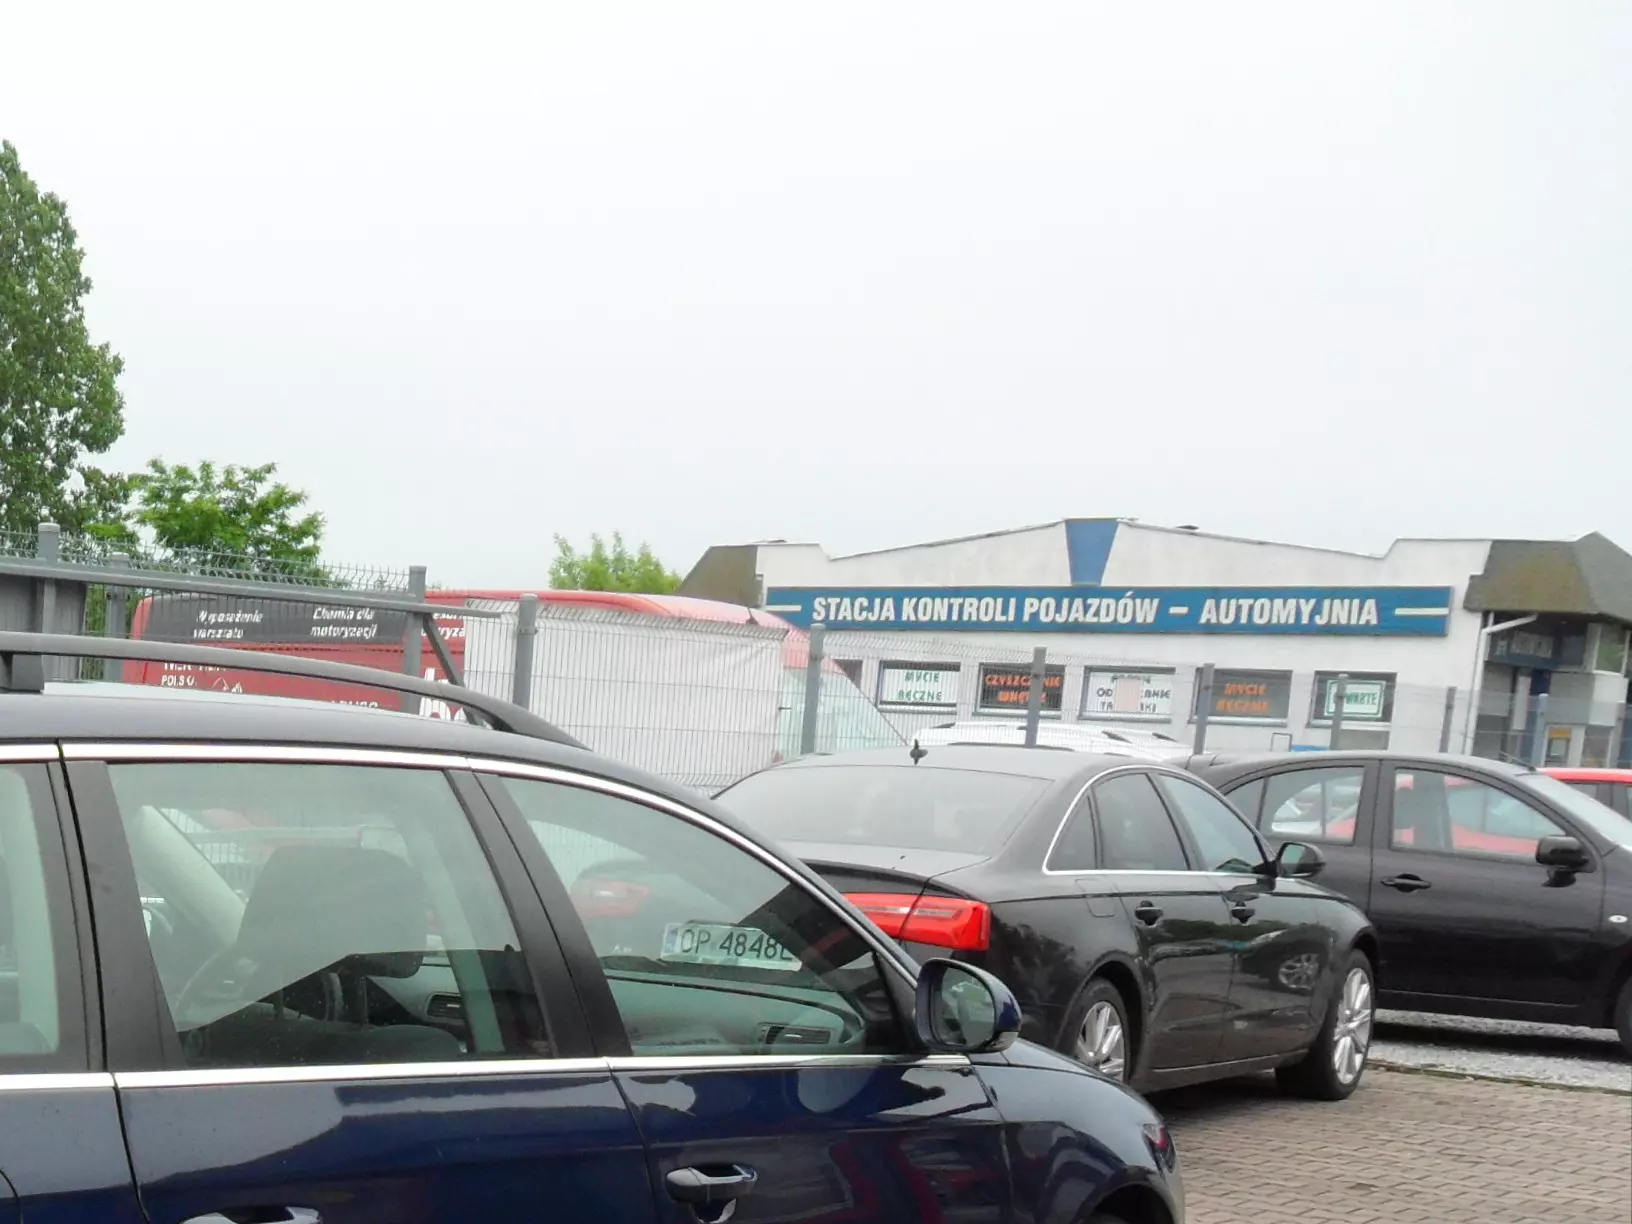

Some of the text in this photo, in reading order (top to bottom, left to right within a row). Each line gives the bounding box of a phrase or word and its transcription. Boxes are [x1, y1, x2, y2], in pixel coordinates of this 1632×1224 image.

[812, 596, 896, 622] STACJA
[901, 596, 1016, 622] KONTROLI
[1022, 590, 1161, 624] POJAZDÓW
[1198, 598, 1379, 625] AUTOMYJNIA
[905, 672, 940, 682] MYCIE
